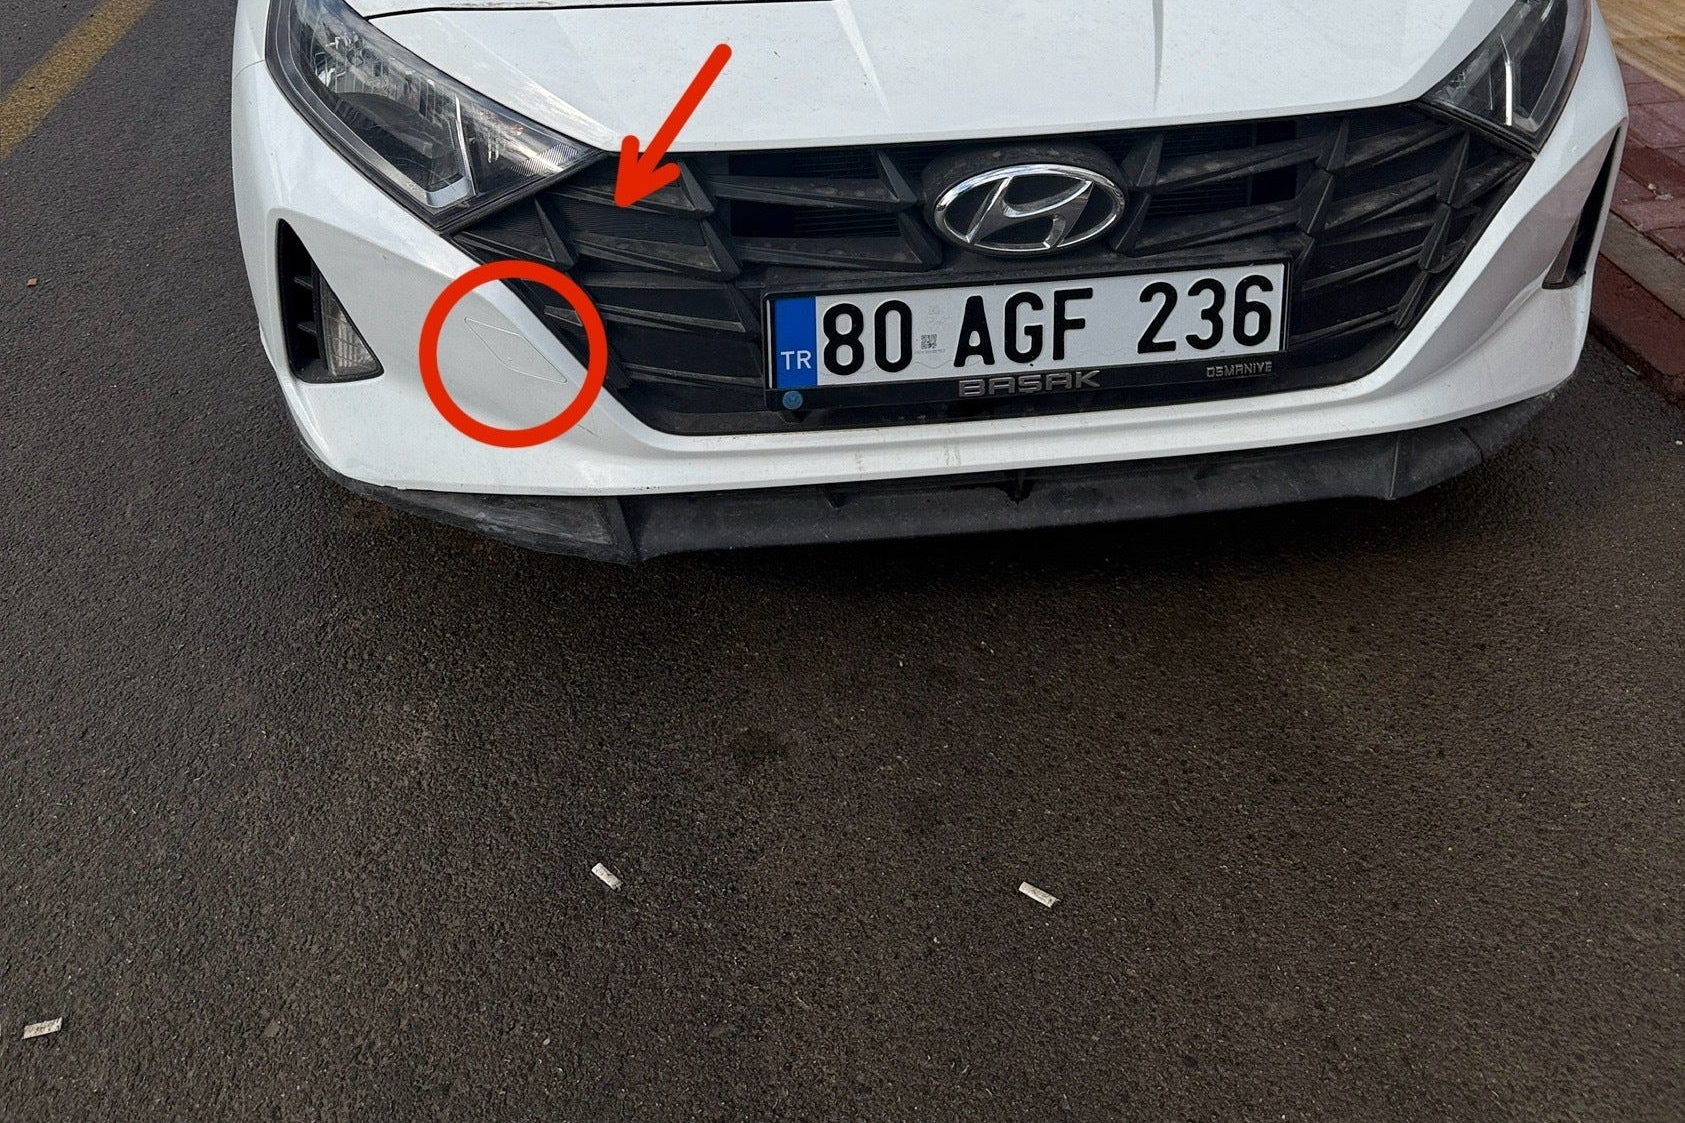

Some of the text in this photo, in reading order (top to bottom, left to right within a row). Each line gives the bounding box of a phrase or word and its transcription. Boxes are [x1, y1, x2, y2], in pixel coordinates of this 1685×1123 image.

[823, 274, 1274, 375] 80 AGF 236
[780, 350, 812, 370] TR
